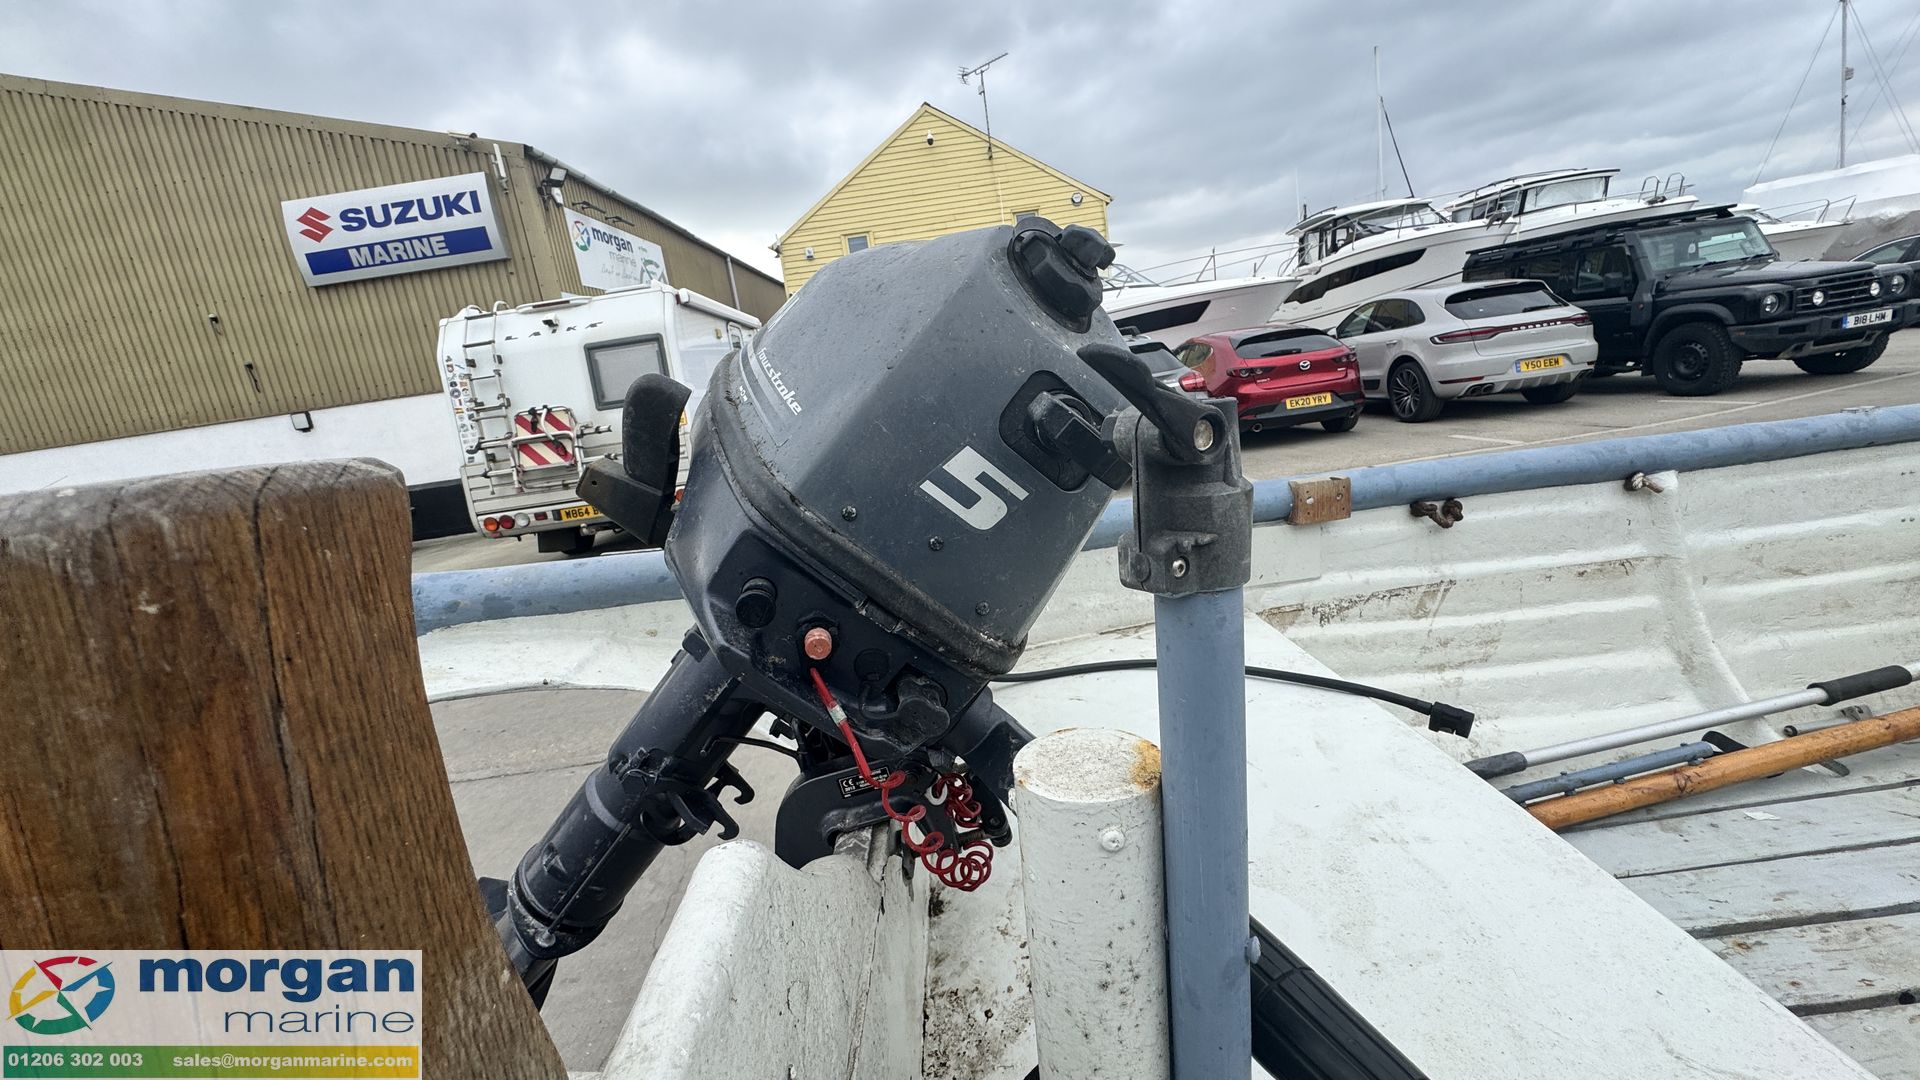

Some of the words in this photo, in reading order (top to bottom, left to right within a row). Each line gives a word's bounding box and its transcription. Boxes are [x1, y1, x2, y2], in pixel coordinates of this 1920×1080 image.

[339, 190, 482, 232] SUZUKI
[348, 235, 450, 268] MARINE
[591, 227, 634, 253] morgan
[1524, 360, 1541, 370] Y50
[1289, 397, 1311, 408] EK20
[1312, 394, 1328, 405] YRY
[919, 445, 1029, 530] 5
